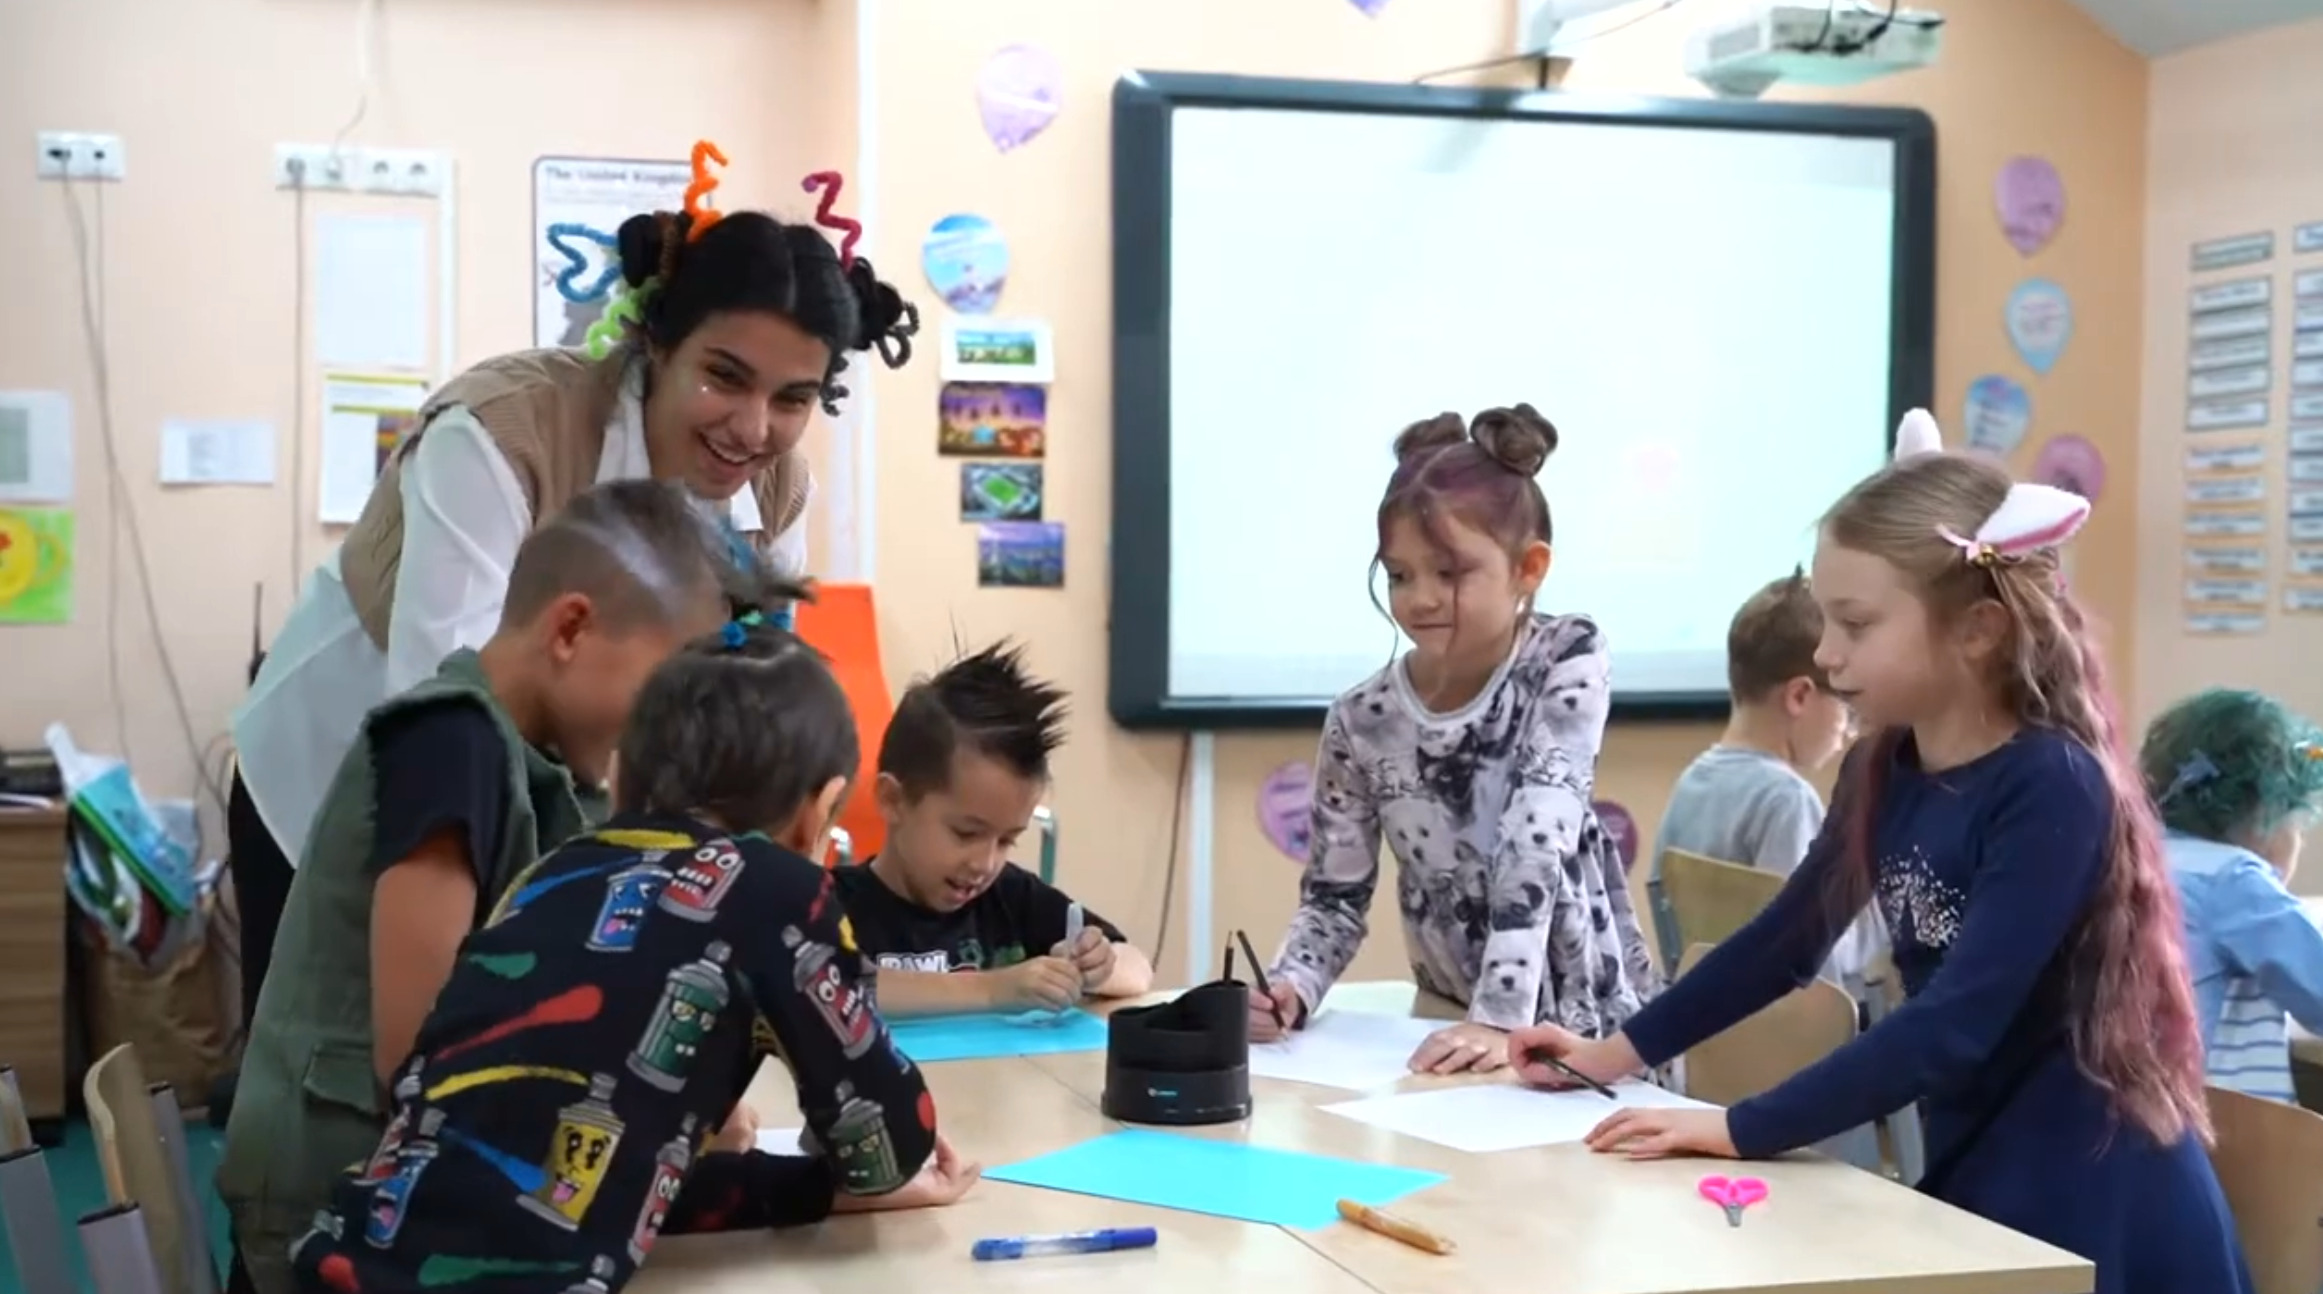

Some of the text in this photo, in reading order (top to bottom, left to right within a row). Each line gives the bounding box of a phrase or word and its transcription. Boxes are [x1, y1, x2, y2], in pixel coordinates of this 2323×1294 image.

[546, 167, 691, 187] The United Kingdo
